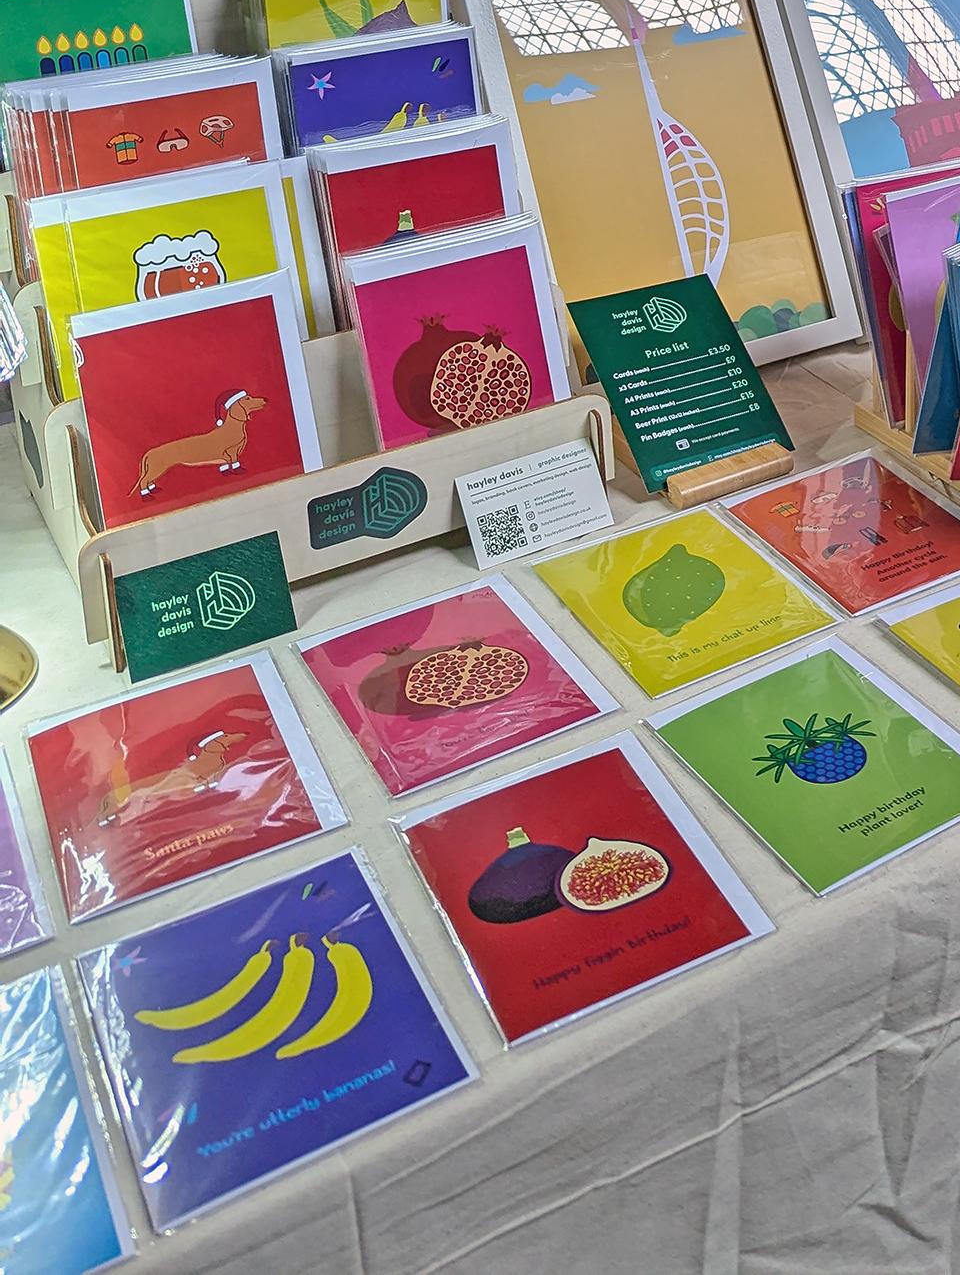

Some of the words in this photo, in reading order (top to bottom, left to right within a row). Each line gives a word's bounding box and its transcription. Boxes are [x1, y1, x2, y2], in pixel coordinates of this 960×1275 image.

[611, 308, 638, 321] hayley
[621, 316, 643, 328] davis
[620, 325, 647, 336] design
[613, 369, 634, 380] Cards
[707, 343, 731, 357] £3.50
[645, 346, 672, 359] Price
[673, 340, 690, 352] list
[618, 383, 628, 393] x3
[627, 379, 648, 390] Cards
[725, 355, 736, 365] £9
[624, 395, 634, 405] A4
[634, 391, 655, 402] Prints
[727, 367, 743, 377] £10
[630, 408, 640, 417] A3
[640, 403, 660, 414] Prints
[731, 378, 748, 390] £20
[635, 420, 651, 430] Beer
[651, 415, 669, 427] Print
[740, 390, 755, 401] £15
[640, 432, 652, 443] Pin
[652, 427, 678, 441] Badges
[749, 402, 761, 413] £8
[466, 475, 498, 492] hayley
[499, 466, 524, 481] davis
[537, 456, 561, 469] graphic
[561, 448, 587, 461] designer
[315, 496, 354, 514] hayley
[323, 508, 355, 525] davis
[319, 522, 356, 540] design
[861, 557, 891, 571] Happy
[876, 559, 913, 576] Another
[914, 550, 937, 563] cycle
[878, 566, 912, 582] around
[911, 561, 928, 571] the
[151, 593, 189, 612] hayley
[161, 606, 192, 623] davis
[157, 620, 194, 638] design
[667, 651, 689, 663] This
[691, 646, 701, 655] is
[702, 641, 719, 651] my
[720, 629, 744, 643] chat
[745, 625, 760, 634] up
[837, 810, 877, 833] Happy
[876, 786, 926, 813] birthday
[860, 815, 892, 837] plant
[890, 799, 924, 819] lover!
[143, 839, 194, 860] Santa
[194, 823, 235, 846] paws
[259, 1097, 321, 1132] utterly
[322, 1059, 397, 1103] bananas!
